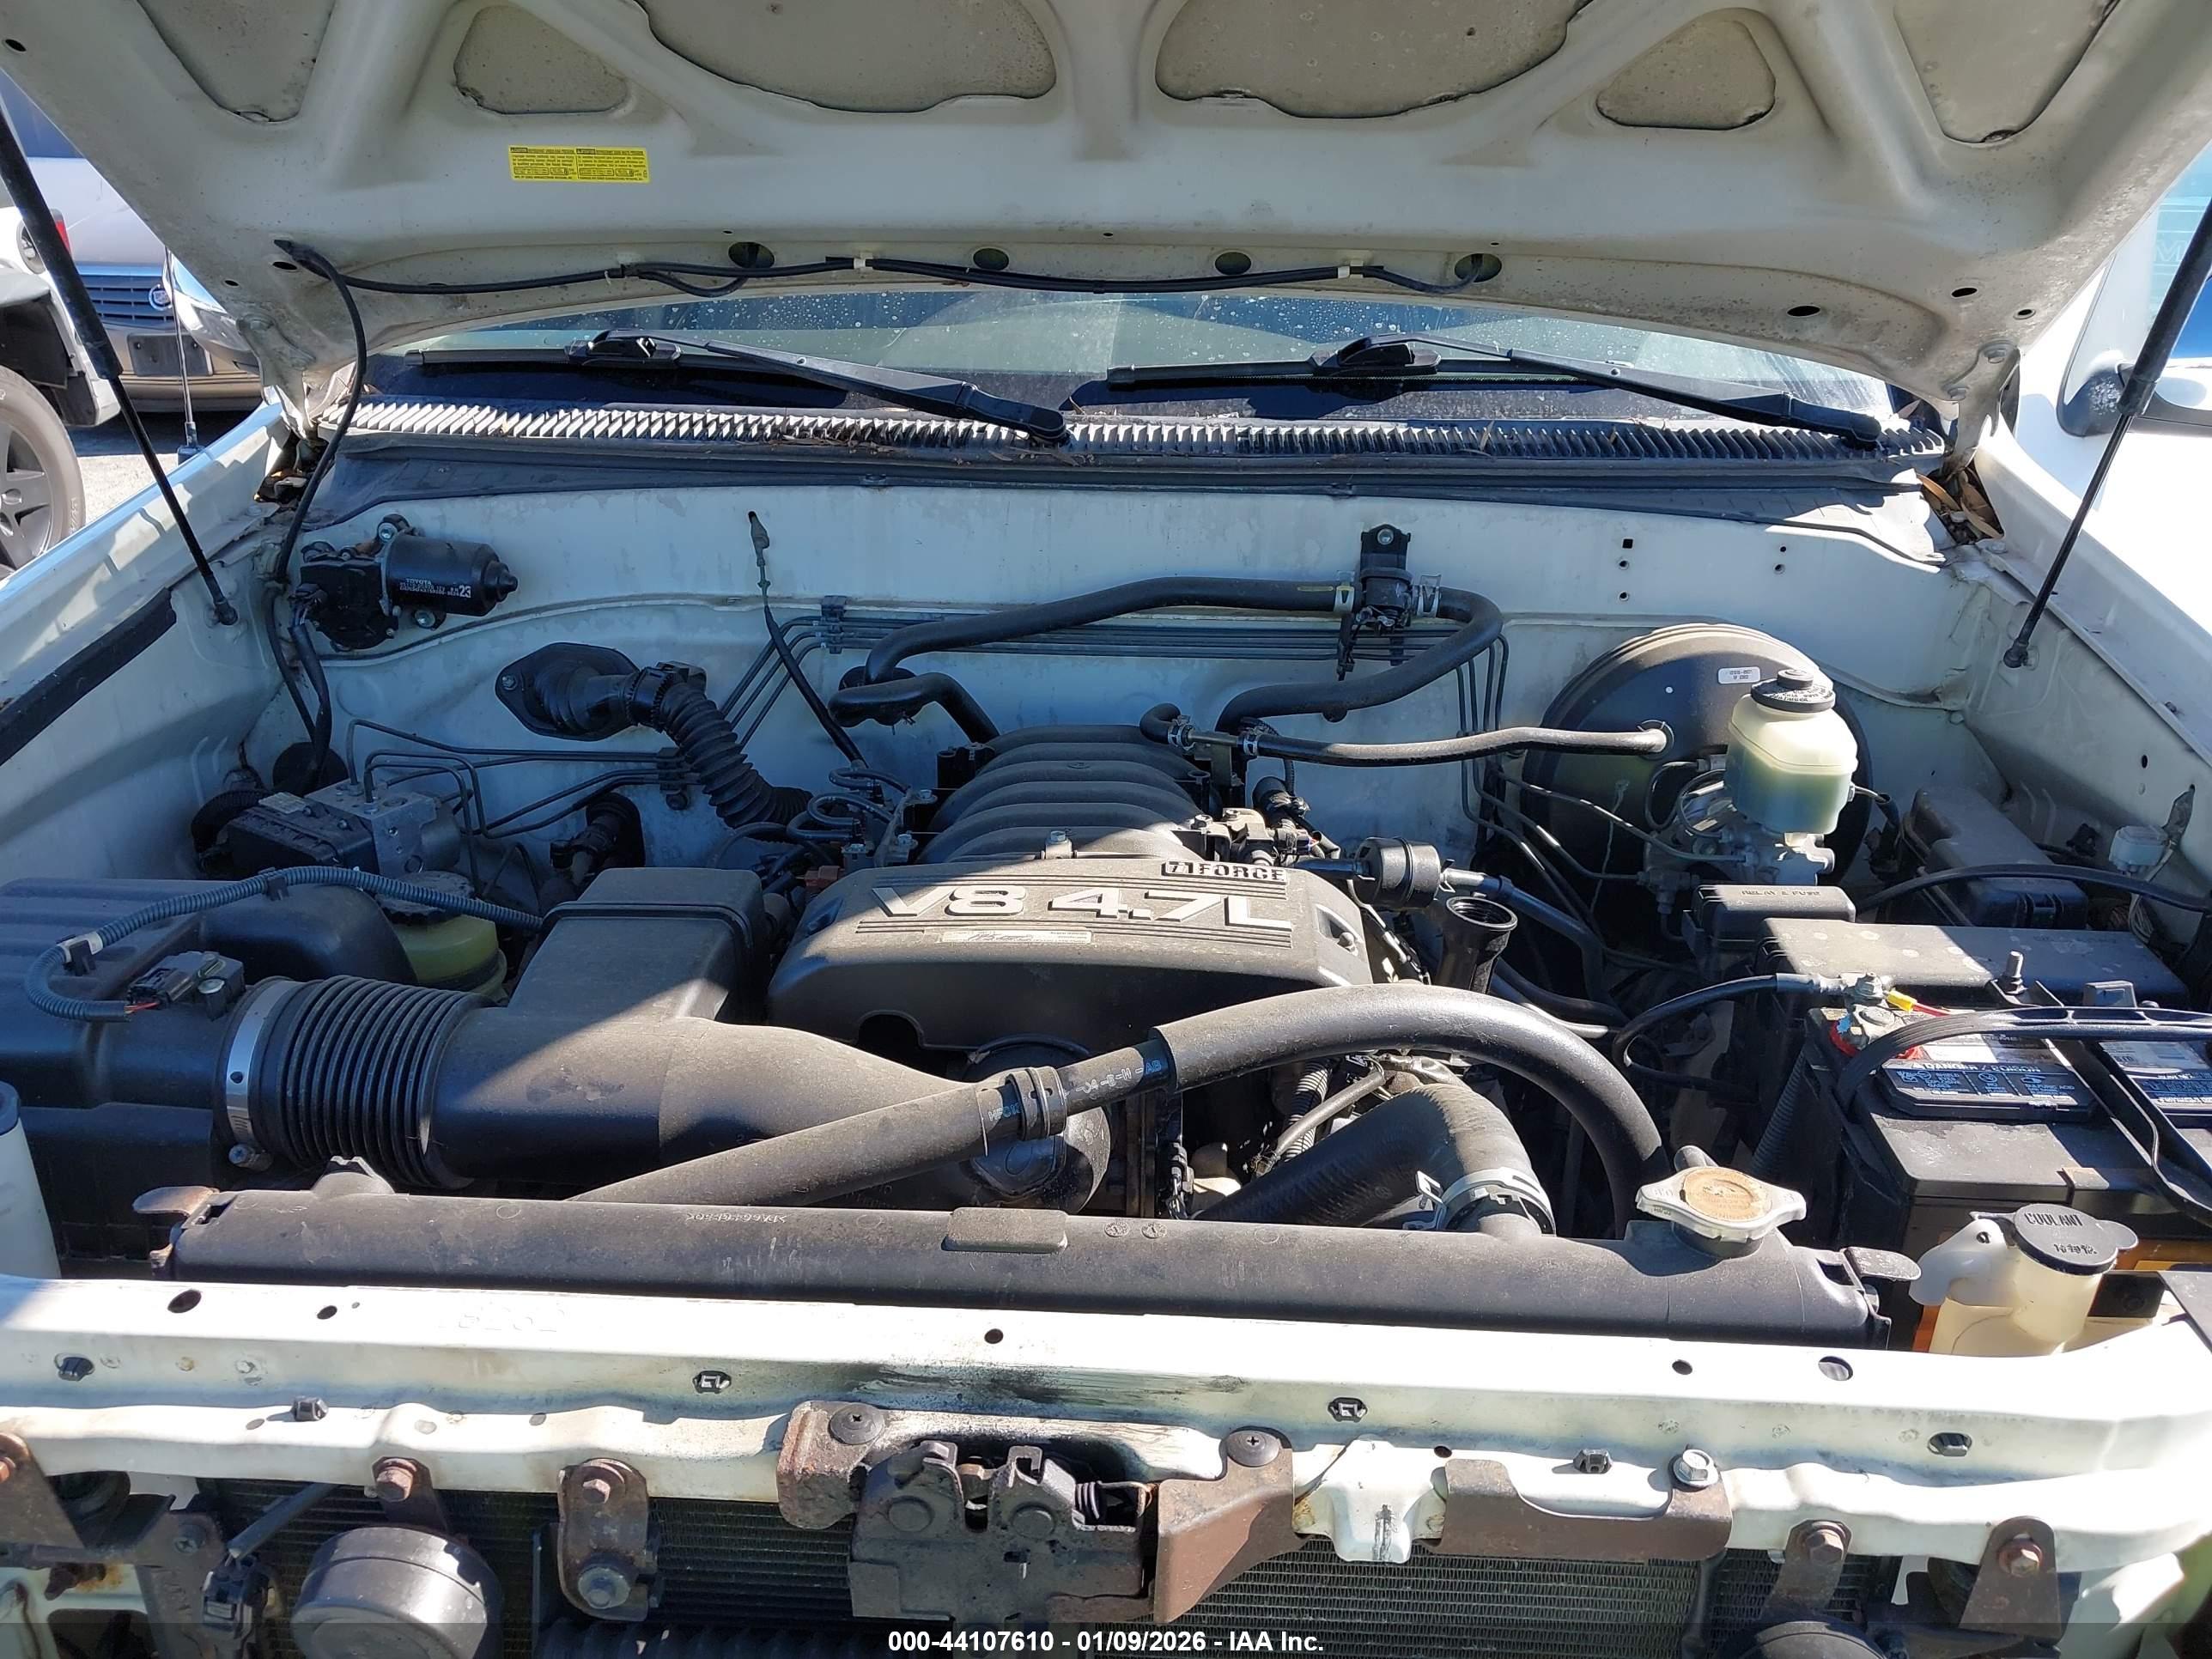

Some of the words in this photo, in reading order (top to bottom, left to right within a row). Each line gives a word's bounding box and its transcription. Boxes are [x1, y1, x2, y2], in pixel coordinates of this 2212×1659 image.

[459, 585, 471, 599] 23
[872, 885, 1026, 917] V8
[1048, 887, 1292, 933] 4.7L
[1926, 1062, 1978, 1071] DANGER
[1990, 1065, 2042, 1073] POISON
[2024, 1212, 2084, 1227] COOLANT
